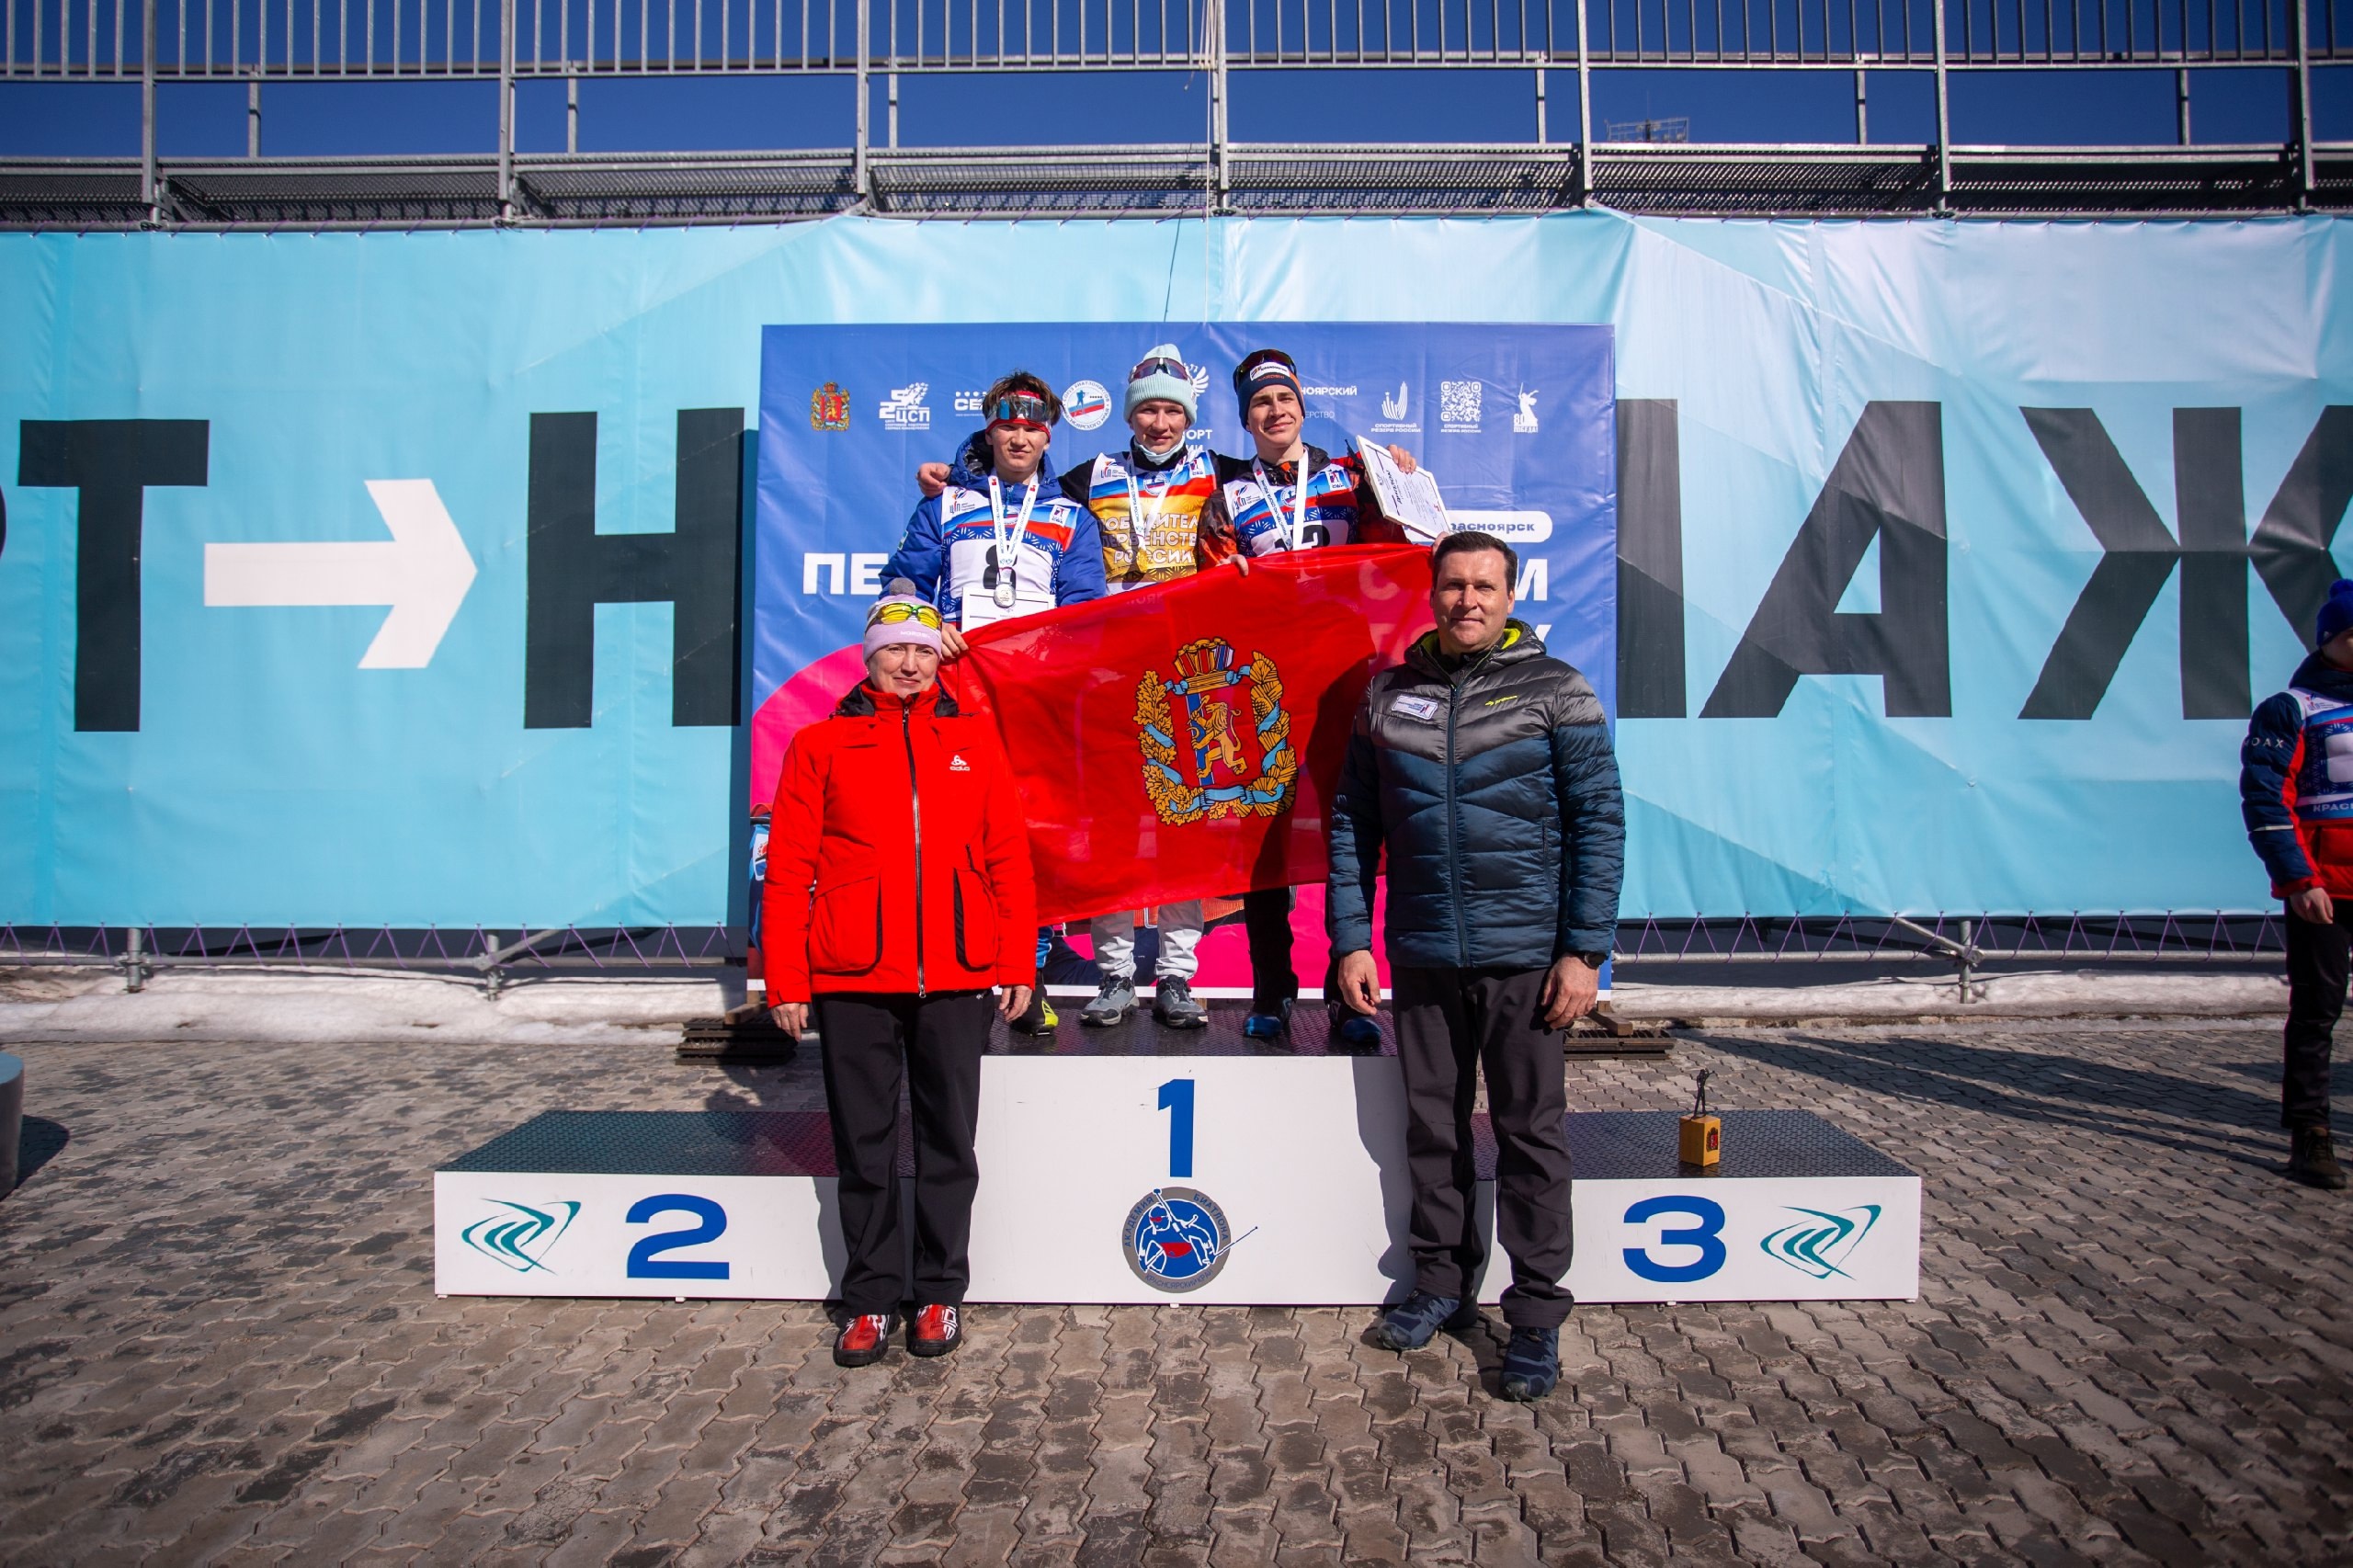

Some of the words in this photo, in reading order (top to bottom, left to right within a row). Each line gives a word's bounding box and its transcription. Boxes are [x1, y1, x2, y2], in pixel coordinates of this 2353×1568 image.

[1302, 386, 1357, 395] НОЯРСКИЙ
[954, 399, 983, 411] СЕ
[896, 410, 930, 425] ЦСП
[1305, 411, 1336, 419] ЕРСТВО
[1186, 429, 1213, 440] ОРТ
[1451, 522, 1535, 534] асноярск
[1114, 549, 1193, 563] РОСИИ
[0, 419, 210, 732] Т
[2313, 801, 2353, 812] КРАС
[1158, 1079, 1195, 1177] 1
[1124, 1197, 1154, 1247] АКАДЕМИЯ
[1193, 1193, 1229, 1241] БИАТЛОНА
[626, 1193, 730, 1279] 2
[1622, 1196, 1726, 1283] 3
